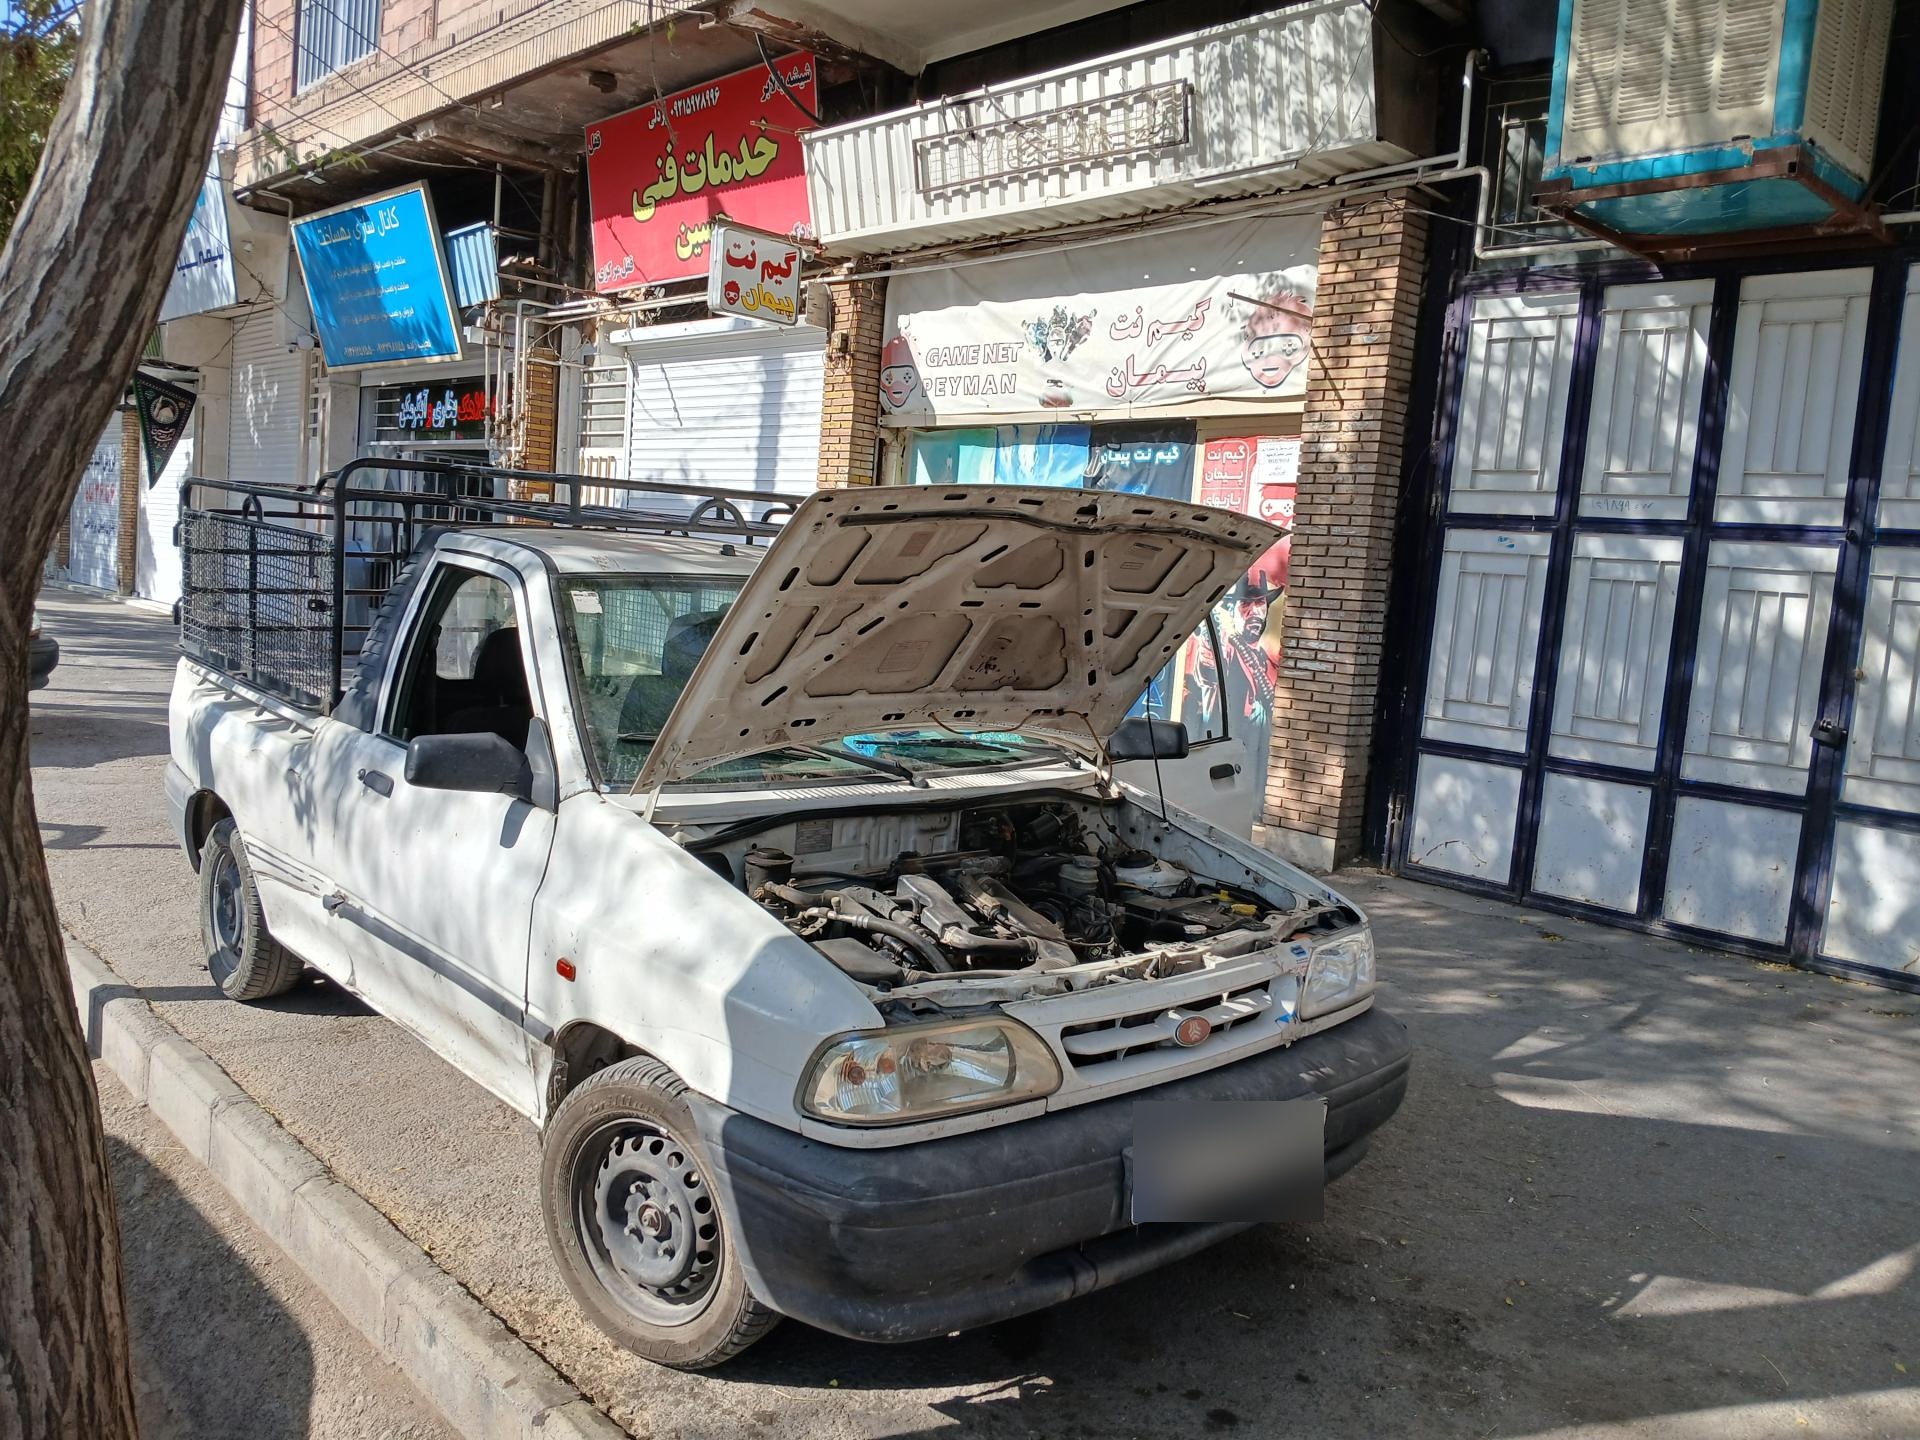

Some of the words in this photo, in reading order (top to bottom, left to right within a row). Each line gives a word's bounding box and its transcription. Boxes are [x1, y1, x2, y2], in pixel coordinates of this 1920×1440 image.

[786, 62, 812, 90] شیشه
[680, 117, 779, 193] خدمات
[632, 142, 678, 222] فنی
[354, 214, 375, 243] سازی
[378, 205, 400, 237] کانال
[726, 240, 757, 269] نت
[761, 252, 797, 285] گیم
[741, 282, 795, 320] پیمان
[1109, 305, 1143, 341] نت
[1147, 297, 1212, 346] گیم
[926, 343, 981, 368] GAME
[983, 341, 1025, 364] NET
[921, 373, 1017, 398] PEYMAN
[1106, 354, 1207, 398] پیمان
[1101, 449, 1130, 468] پیمان
[1133, 447, 1152, 461] نت
[1155, 445, 1179, 465] گیم
[1207, 447, 1221, 462] نت
[1222, 445, 1245, 464] گیم
[1204, 467, 1244, 487] پیمان
